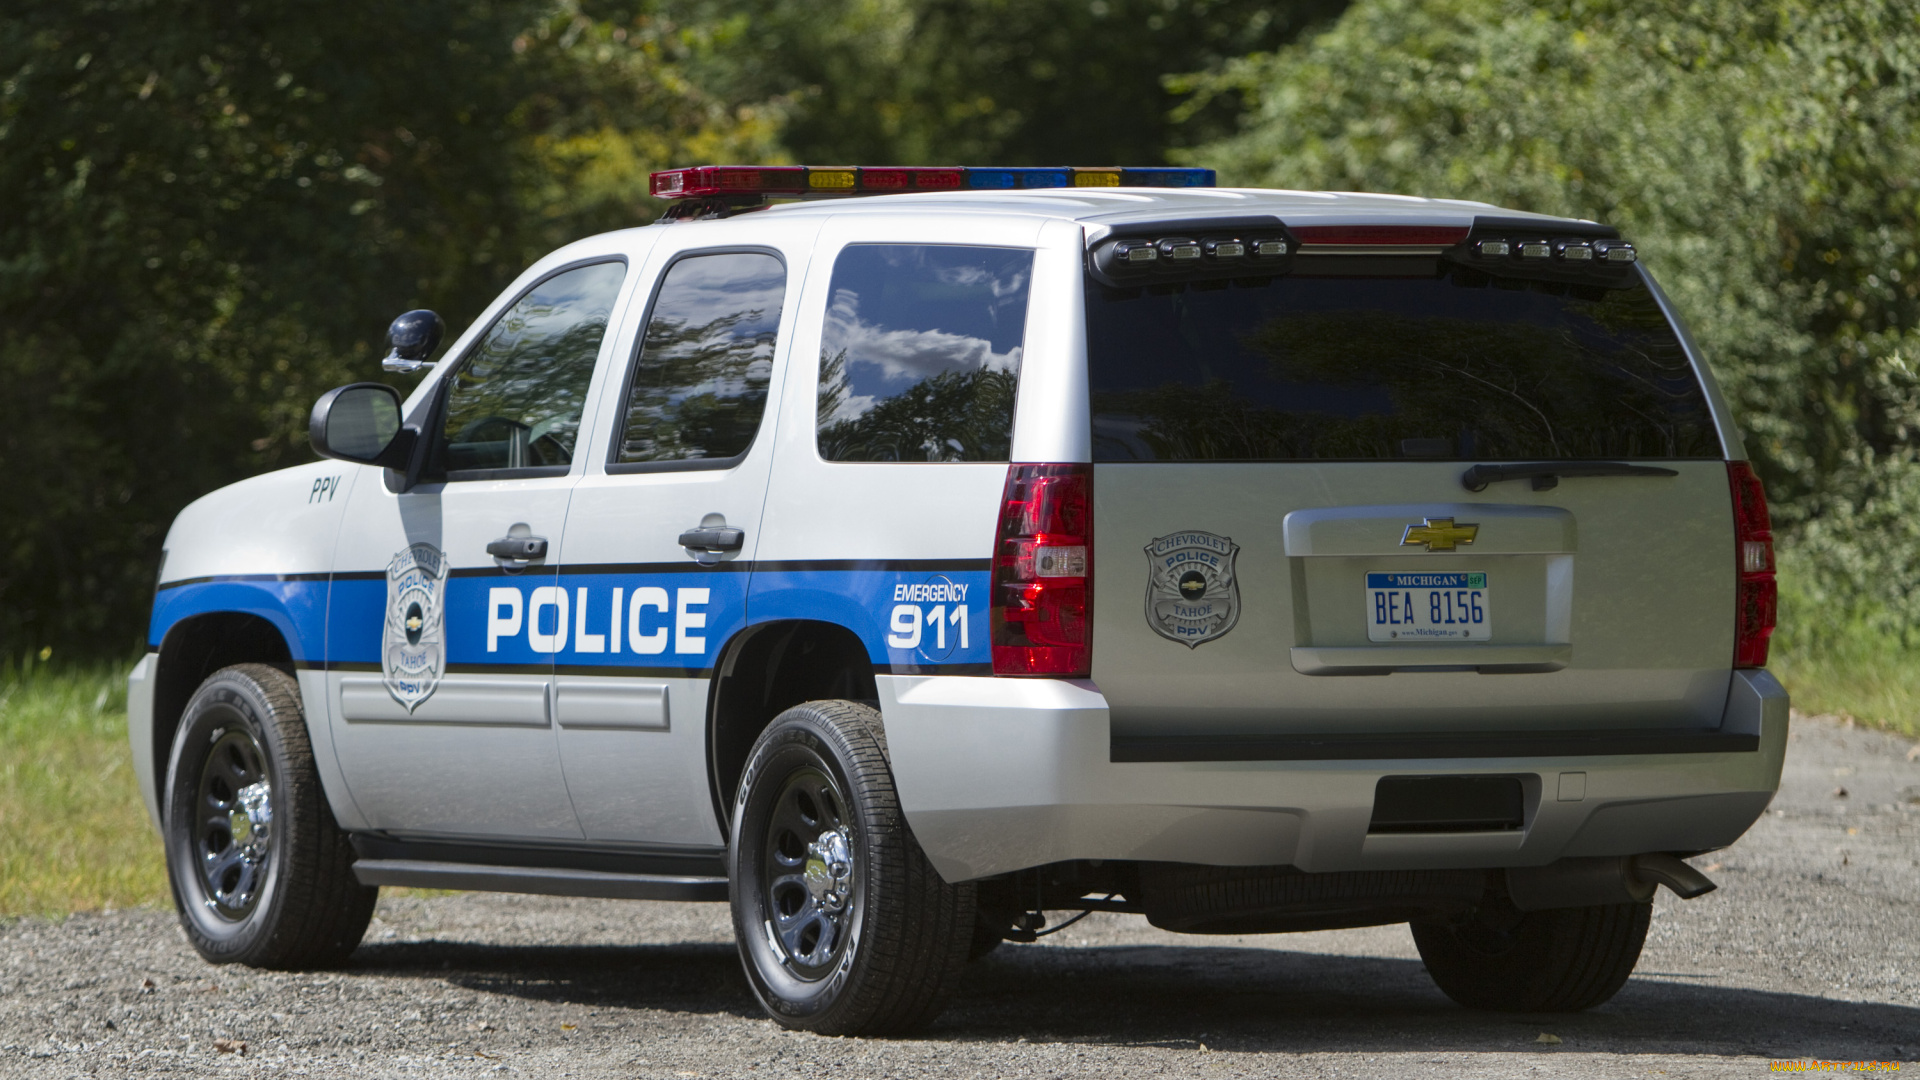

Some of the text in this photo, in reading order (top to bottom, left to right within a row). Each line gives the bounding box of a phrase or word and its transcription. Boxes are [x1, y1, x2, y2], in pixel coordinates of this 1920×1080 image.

[309, 475, 342, 504] PPV
[1157, 535, 1227, 552] CHEVROLET
[394, 548, 441, 573] CHEVROLET
[1166, 551, 1220, 567] POLICE
[398, 574, 435, 595] POLICE
[1396, 575, 1458, 586] MICHIGAN
[893, 584, 969, 602] EMERGENCY
[1173, 604, 1213, 617] TAHOE
[1375, 591, 1484, 625] BEA 8156
[486, 586, 711, 655] POLICE
[888, 604, 969, 649] 911
[1177, 625, 1209, 636] PPV
[400, 651, 427, 669] TAHOE
[399, 681, 420, 695] PPV
